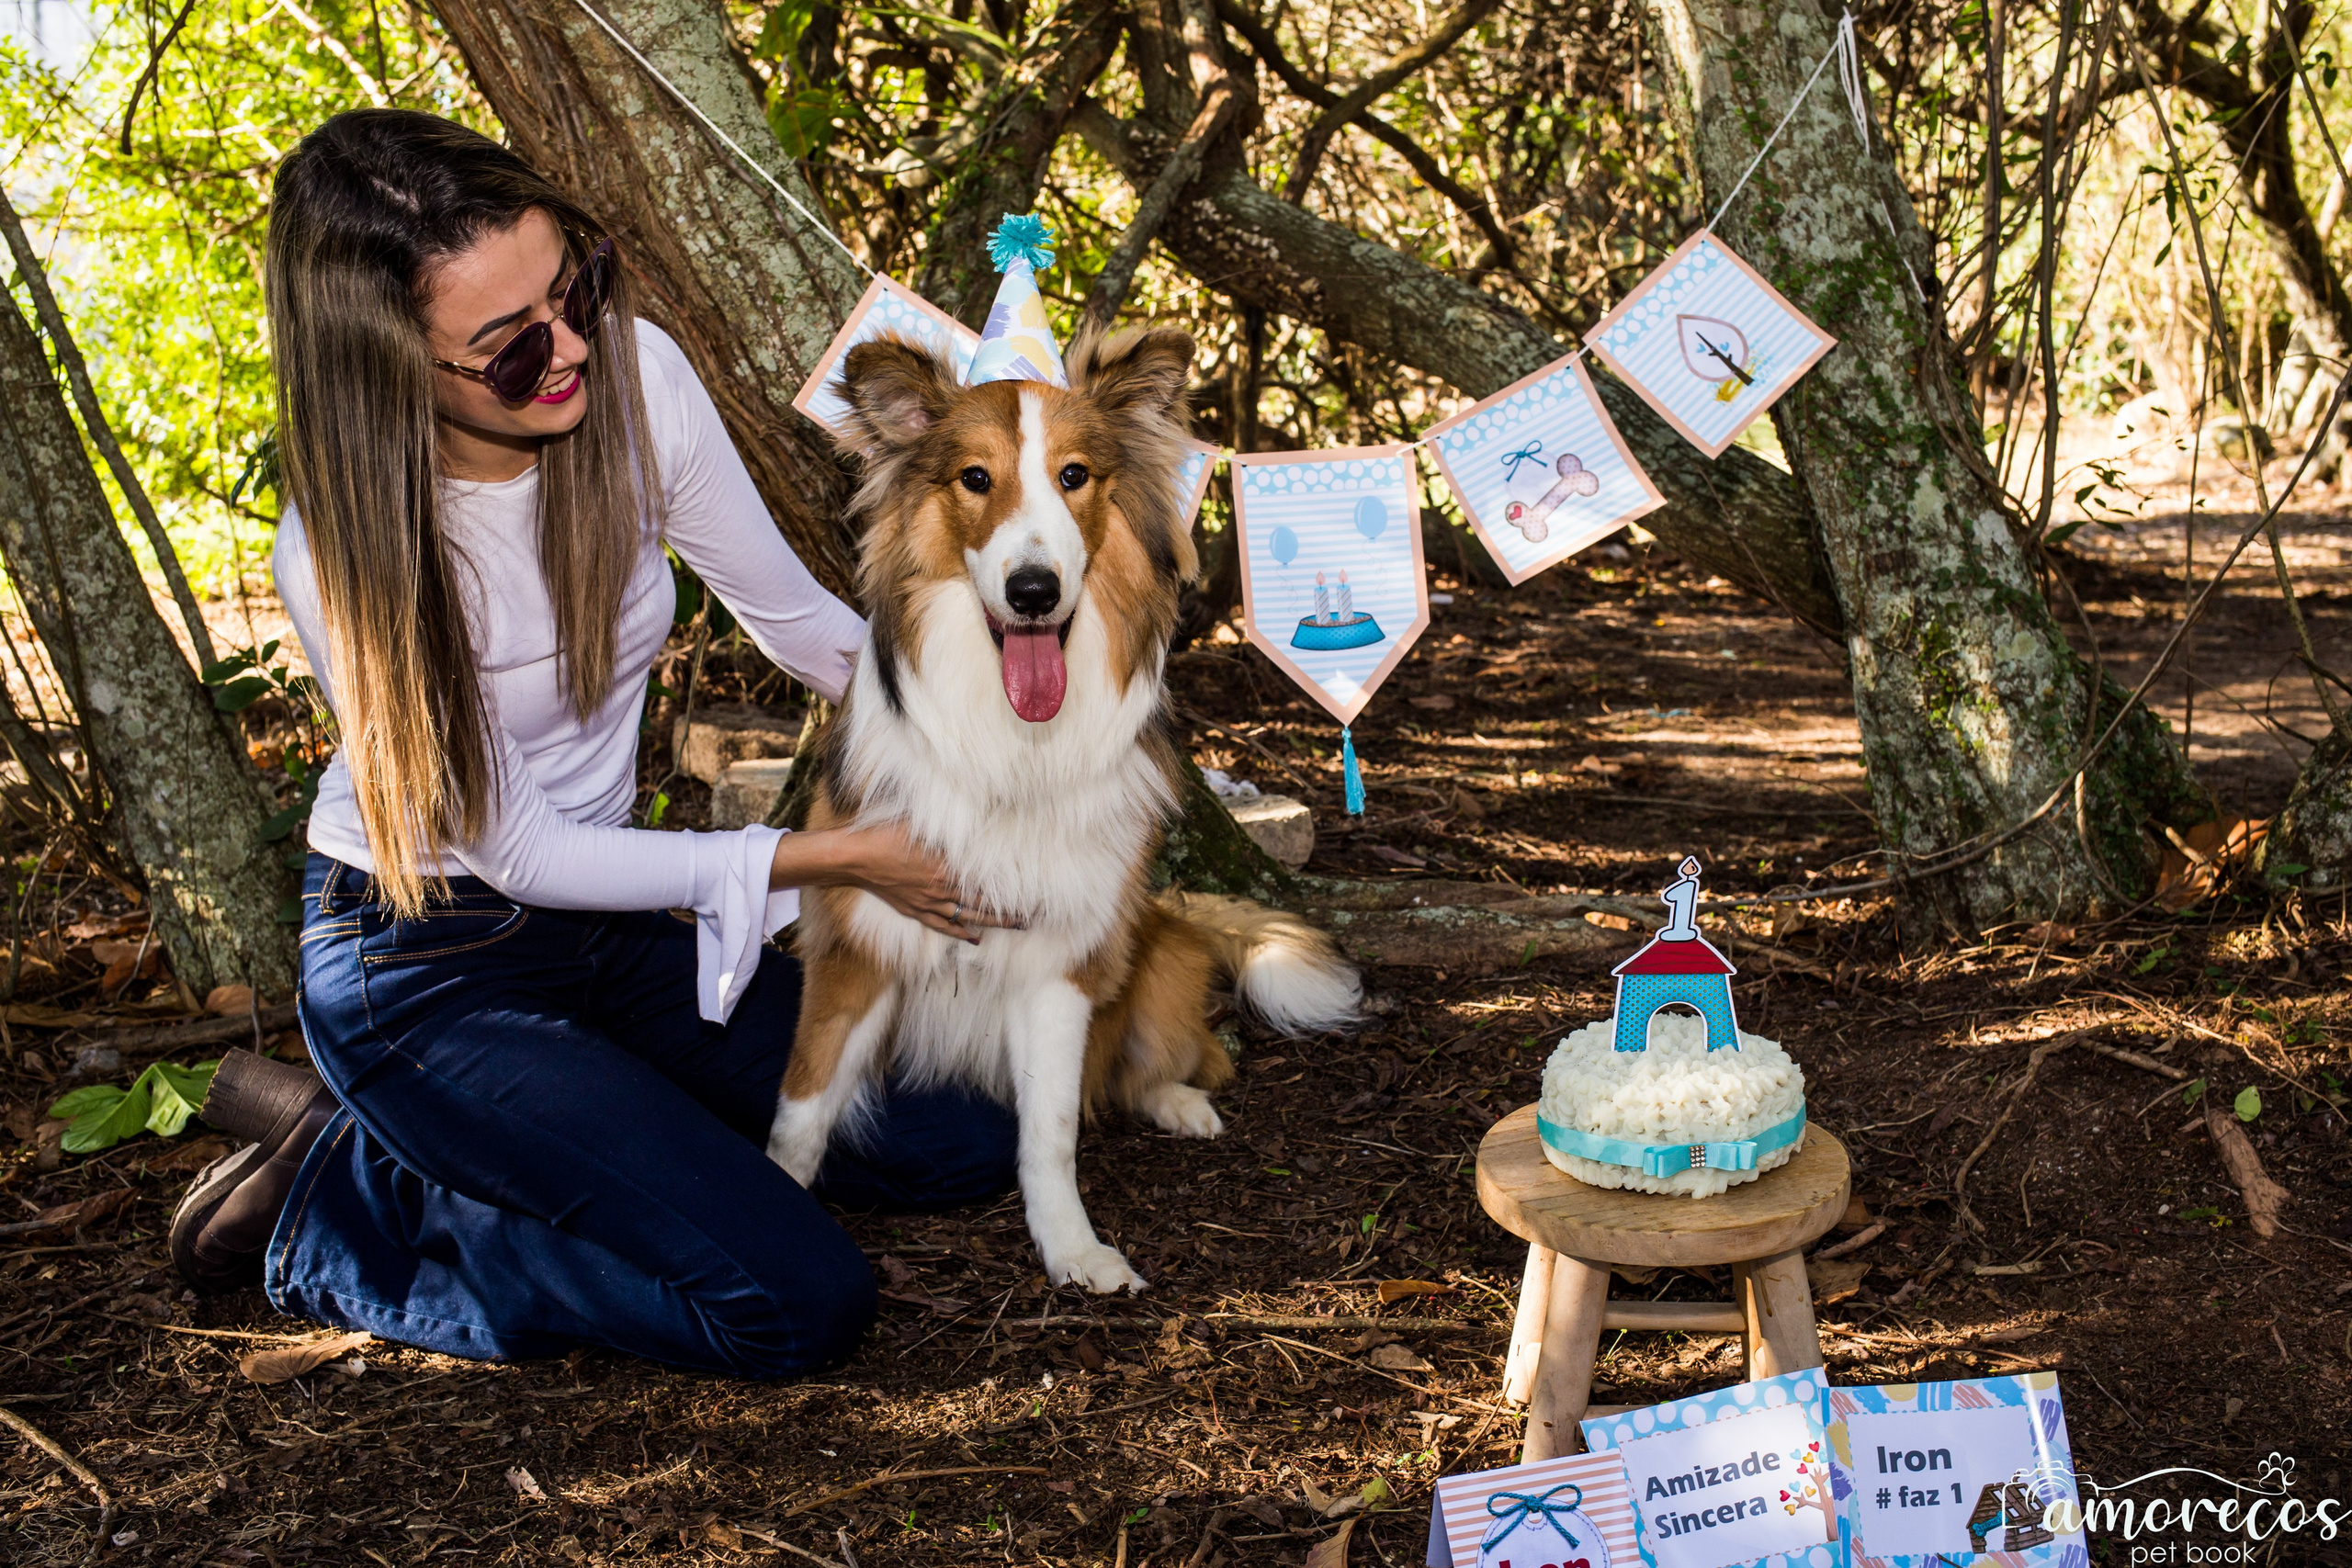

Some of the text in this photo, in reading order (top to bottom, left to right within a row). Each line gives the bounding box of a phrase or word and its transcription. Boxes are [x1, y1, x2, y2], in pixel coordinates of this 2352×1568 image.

[1659, 880, 1698, 942] 1
[1645, 1450, 1781, 1502] Amizade
[1876, 1446, 1952, 1473] Iron
[1655, 1495, 1769, 1540] Sincera
[1898, 1485, 1940, 1507] faz
[1951, 1483, 1962, 1504] 1
